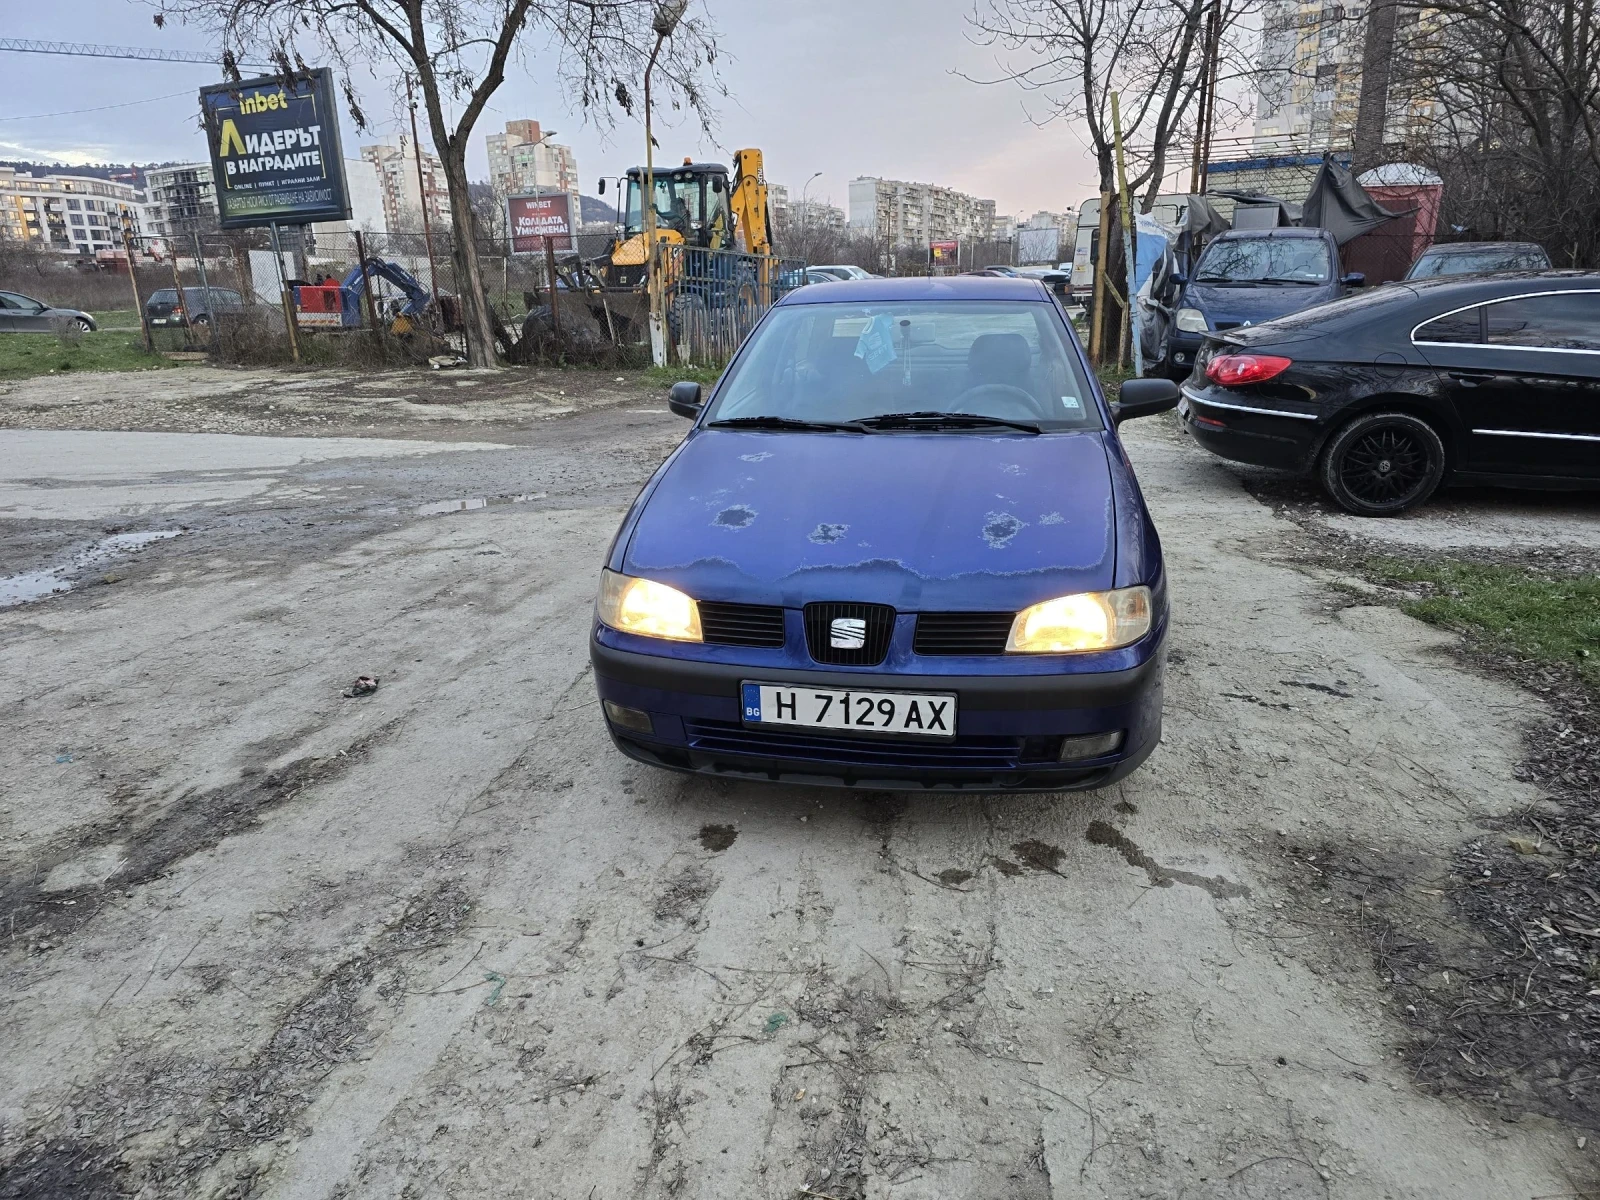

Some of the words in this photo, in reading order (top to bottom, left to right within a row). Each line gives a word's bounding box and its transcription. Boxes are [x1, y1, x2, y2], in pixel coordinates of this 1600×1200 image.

[239, 90, 288, 115] inbet
[220, 119, 321, 157] ЛИДЕРЪТ
[226, 161, 237, 175] В
[239, 151, 321, 175] НАГРАДИТЕ
[746, 707, 760, 717] BG
[776, 691, 797, 721] H
[814, 694, 896, 727] 7129
[903, 700, 948, 731] AX
